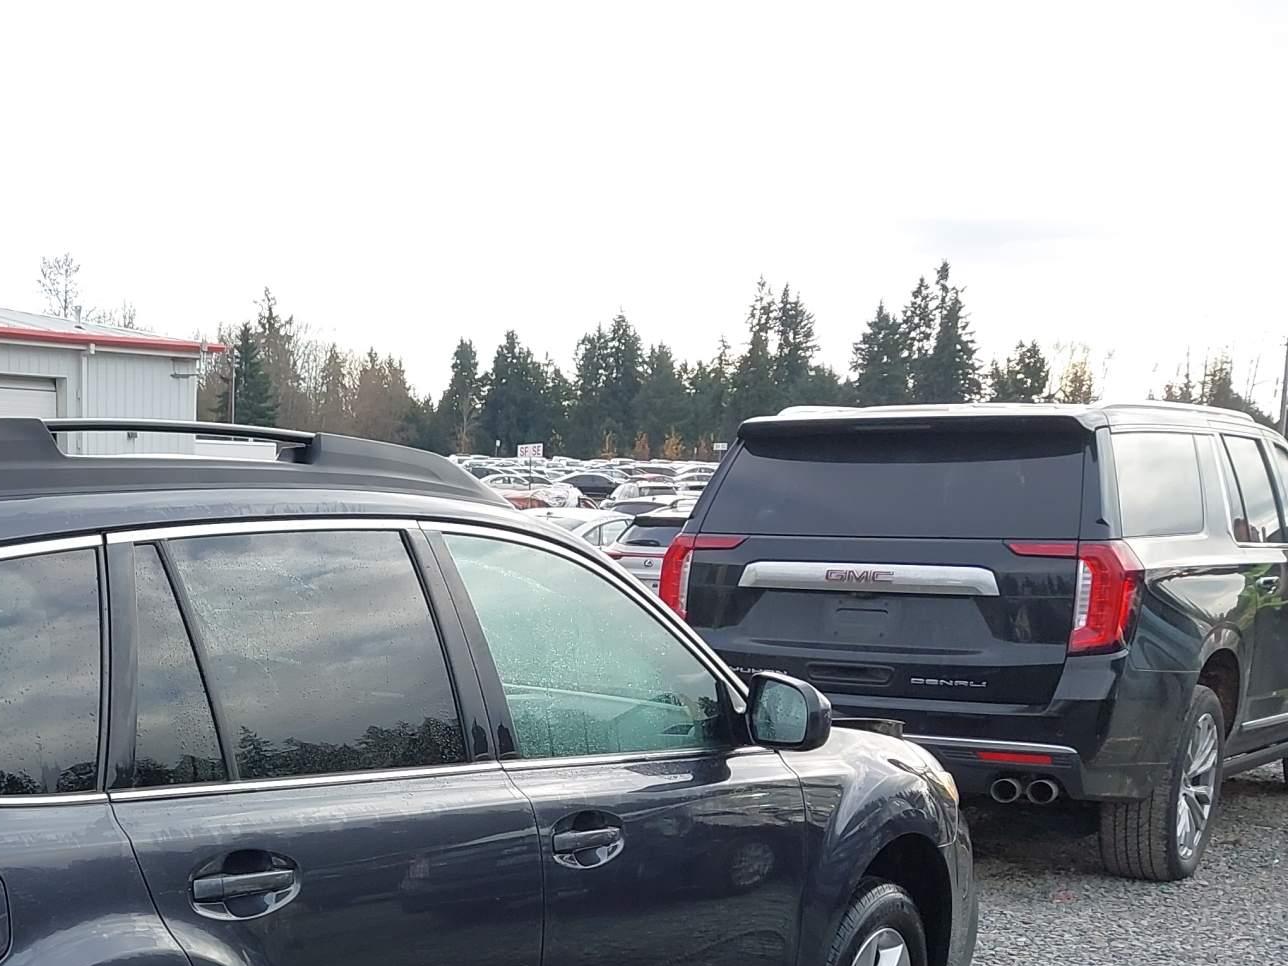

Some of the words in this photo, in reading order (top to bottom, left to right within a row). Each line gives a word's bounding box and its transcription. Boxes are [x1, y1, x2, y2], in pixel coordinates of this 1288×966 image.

[532, 445, 542, 456] SE
[825, 569, 895, 583] GMC
[910, 677, 987, 688] DENALI
